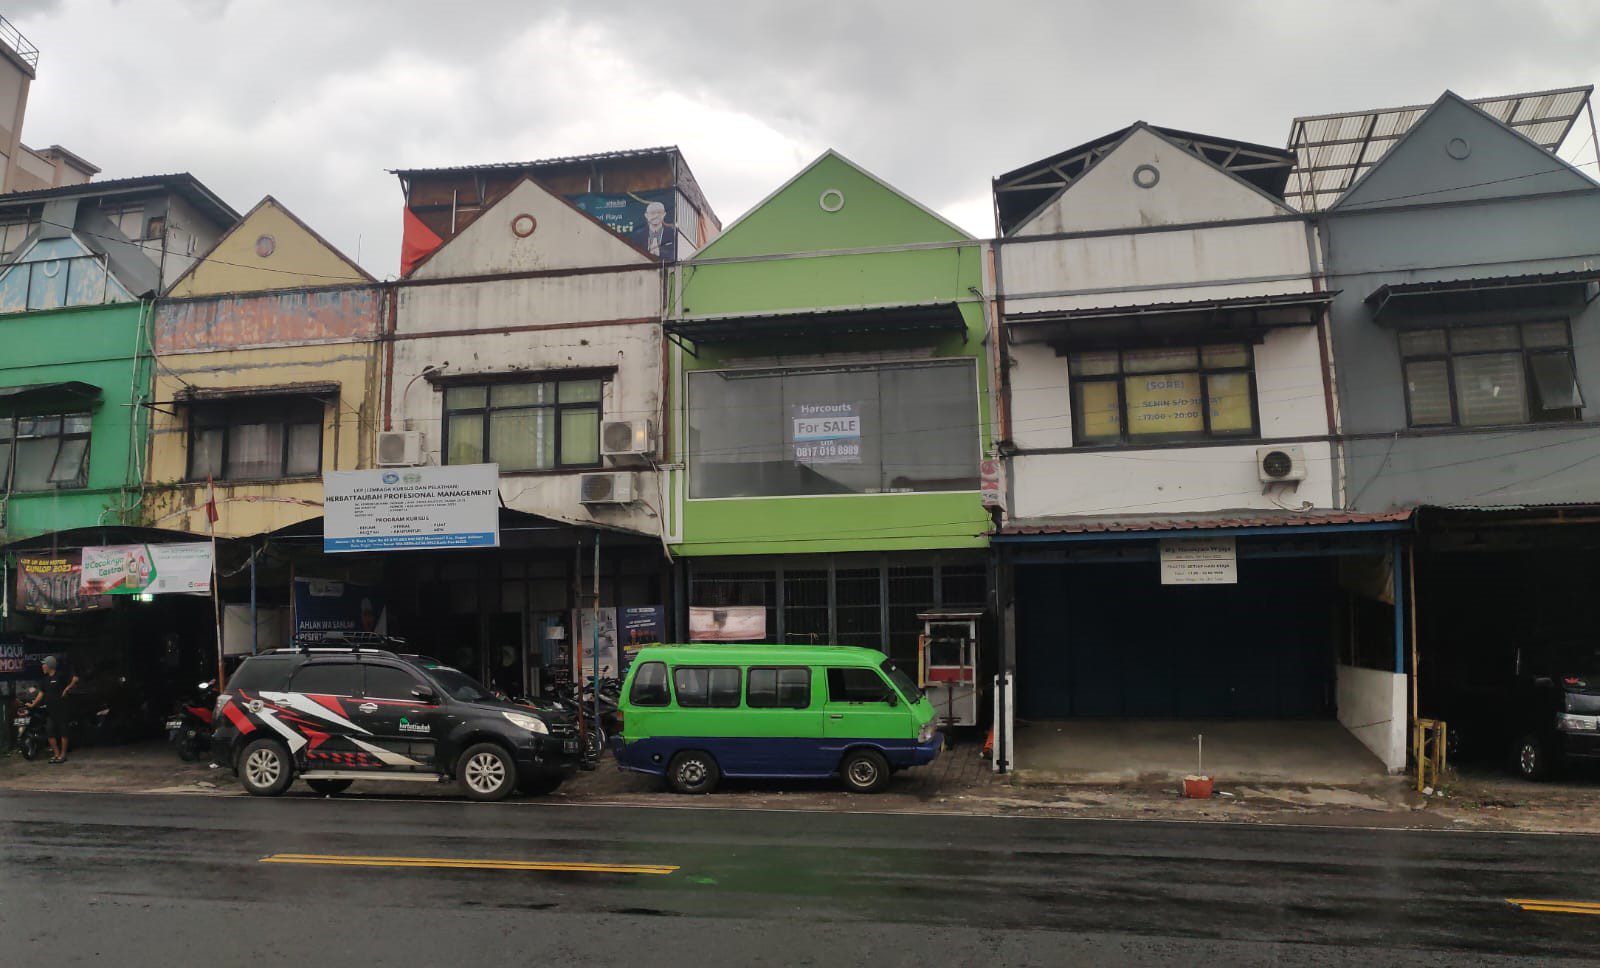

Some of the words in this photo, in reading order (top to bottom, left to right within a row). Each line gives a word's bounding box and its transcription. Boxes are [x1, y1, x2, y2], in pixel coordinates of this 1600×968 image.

[1146, 380, 1185, 392] (SORE)
[801, 403, 852, 413] Harcourts
[798, 422, 819, 433] For
[823, 420, 856, 432] SALE
[796, 447, 817, 457] 0817
[820, 446, 836, 456] 019
[326, 493, 383, 502] HERBATTAUBAH
[384, 491, 435, 500] PROFESIONAL
[437, 489, 492, 497] MANAGEMENT
[25, 565, 52, 573] DUNLOP
[98, 566, 124, 577] Castrol
[300, 620, 321, 629] AHLAN
[0, 643, 24, 657] LIQUI
[0, 659, 24, 671] MOLY
